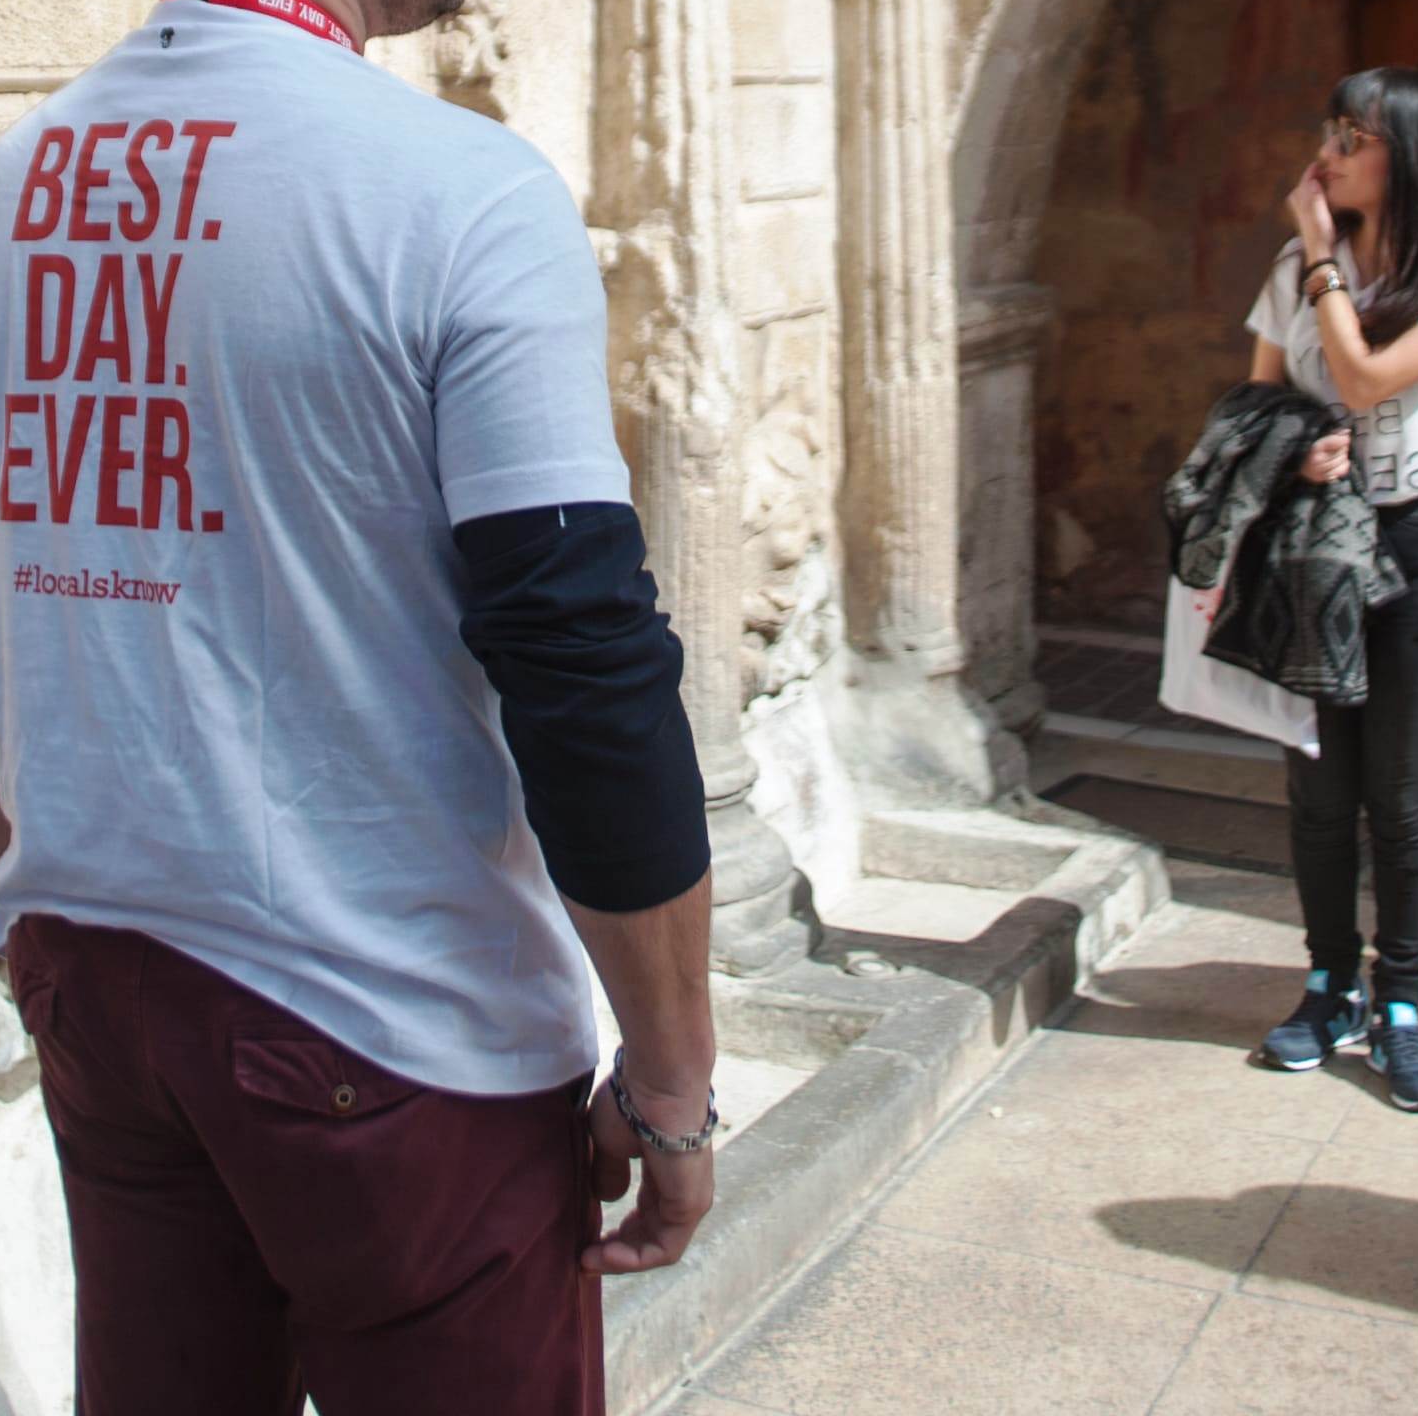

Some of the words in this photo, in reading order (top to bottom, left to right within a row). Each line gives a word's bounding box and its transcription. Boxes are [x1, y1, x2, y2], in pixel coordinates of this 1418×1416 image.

[298, 2, 325, 29] DAY.
[11, 119, 237, 242] BEST.
[23, 253, 187, 386] DAY.
[13, 563, 182, 605] #localsknow
